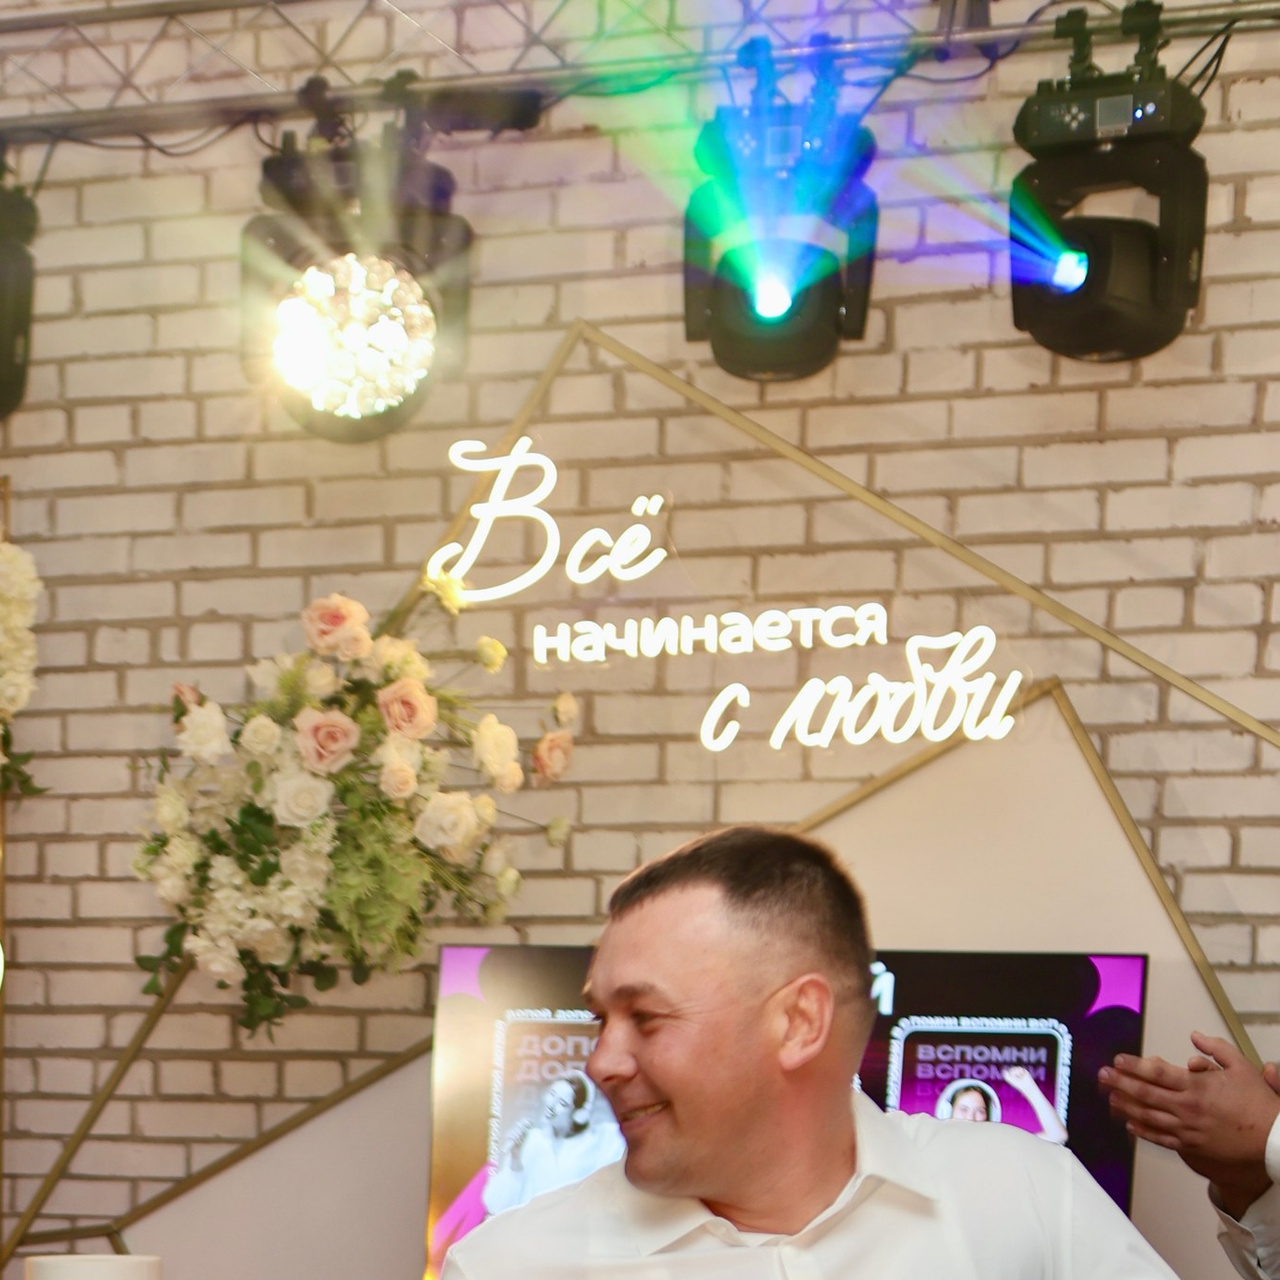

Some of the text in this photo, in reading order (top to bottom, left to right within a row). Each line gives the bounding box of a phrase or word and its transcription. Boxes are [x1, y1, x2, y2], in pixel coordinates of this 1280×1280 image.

[426, 436, 668, 602] Всё
[533, 602, 888, 664] начинается
[700, 625, 1024, 752] с любви
[916, 1044, 1047, 1064] ВСПОМНИ
[916, 1062, 1046, 1082] ВСПОМИ
